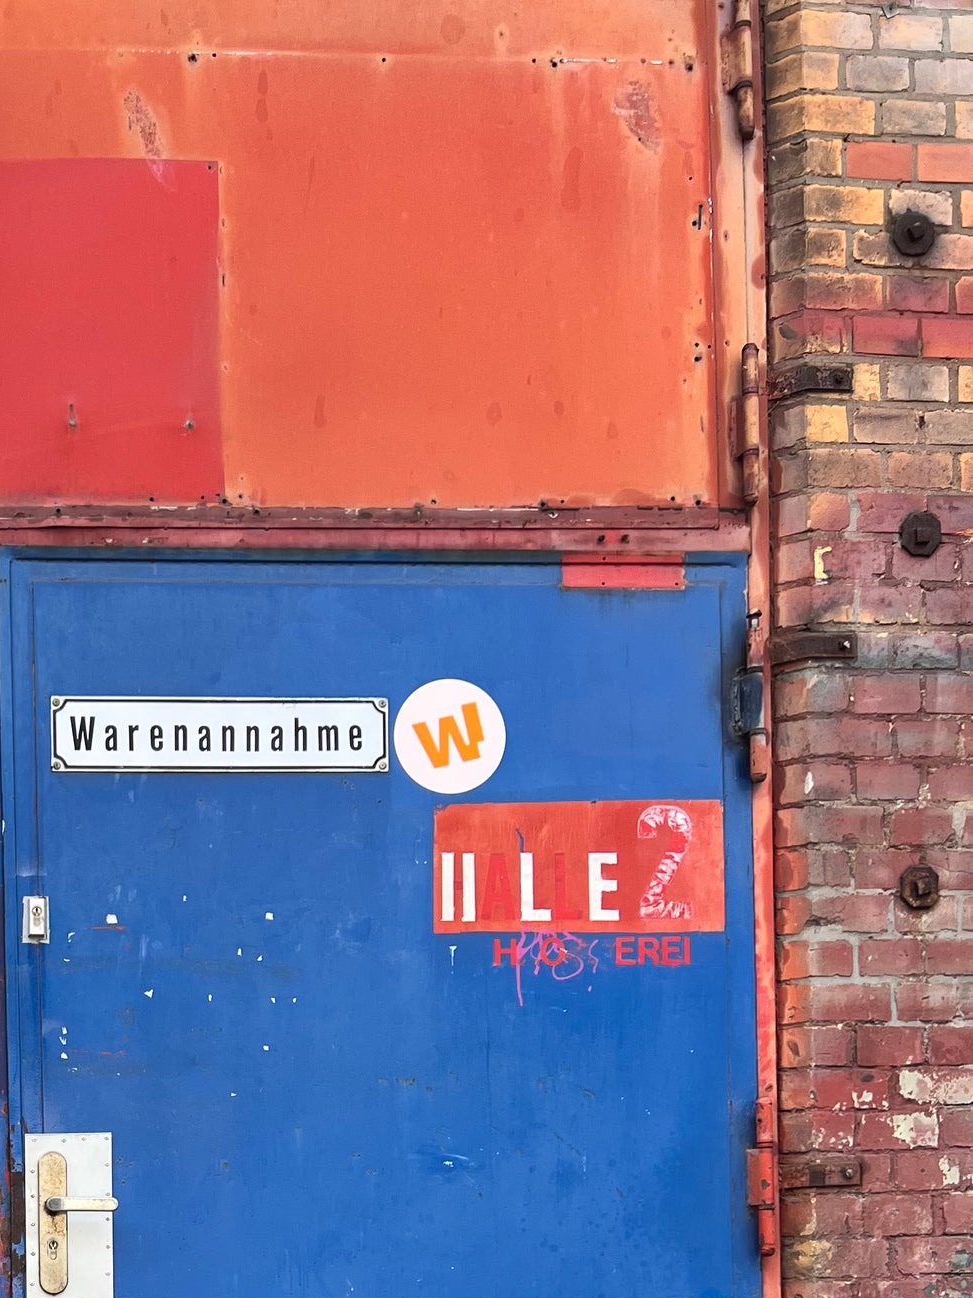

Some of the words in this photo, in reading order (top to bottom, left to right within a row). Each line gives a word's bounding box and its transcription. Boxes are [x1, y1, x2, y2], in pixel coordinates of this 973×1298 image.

[69, 715, 364, 753] Warenannahme
[412, 701, 485, 769] W
[637, 804, 693, 920] 2
